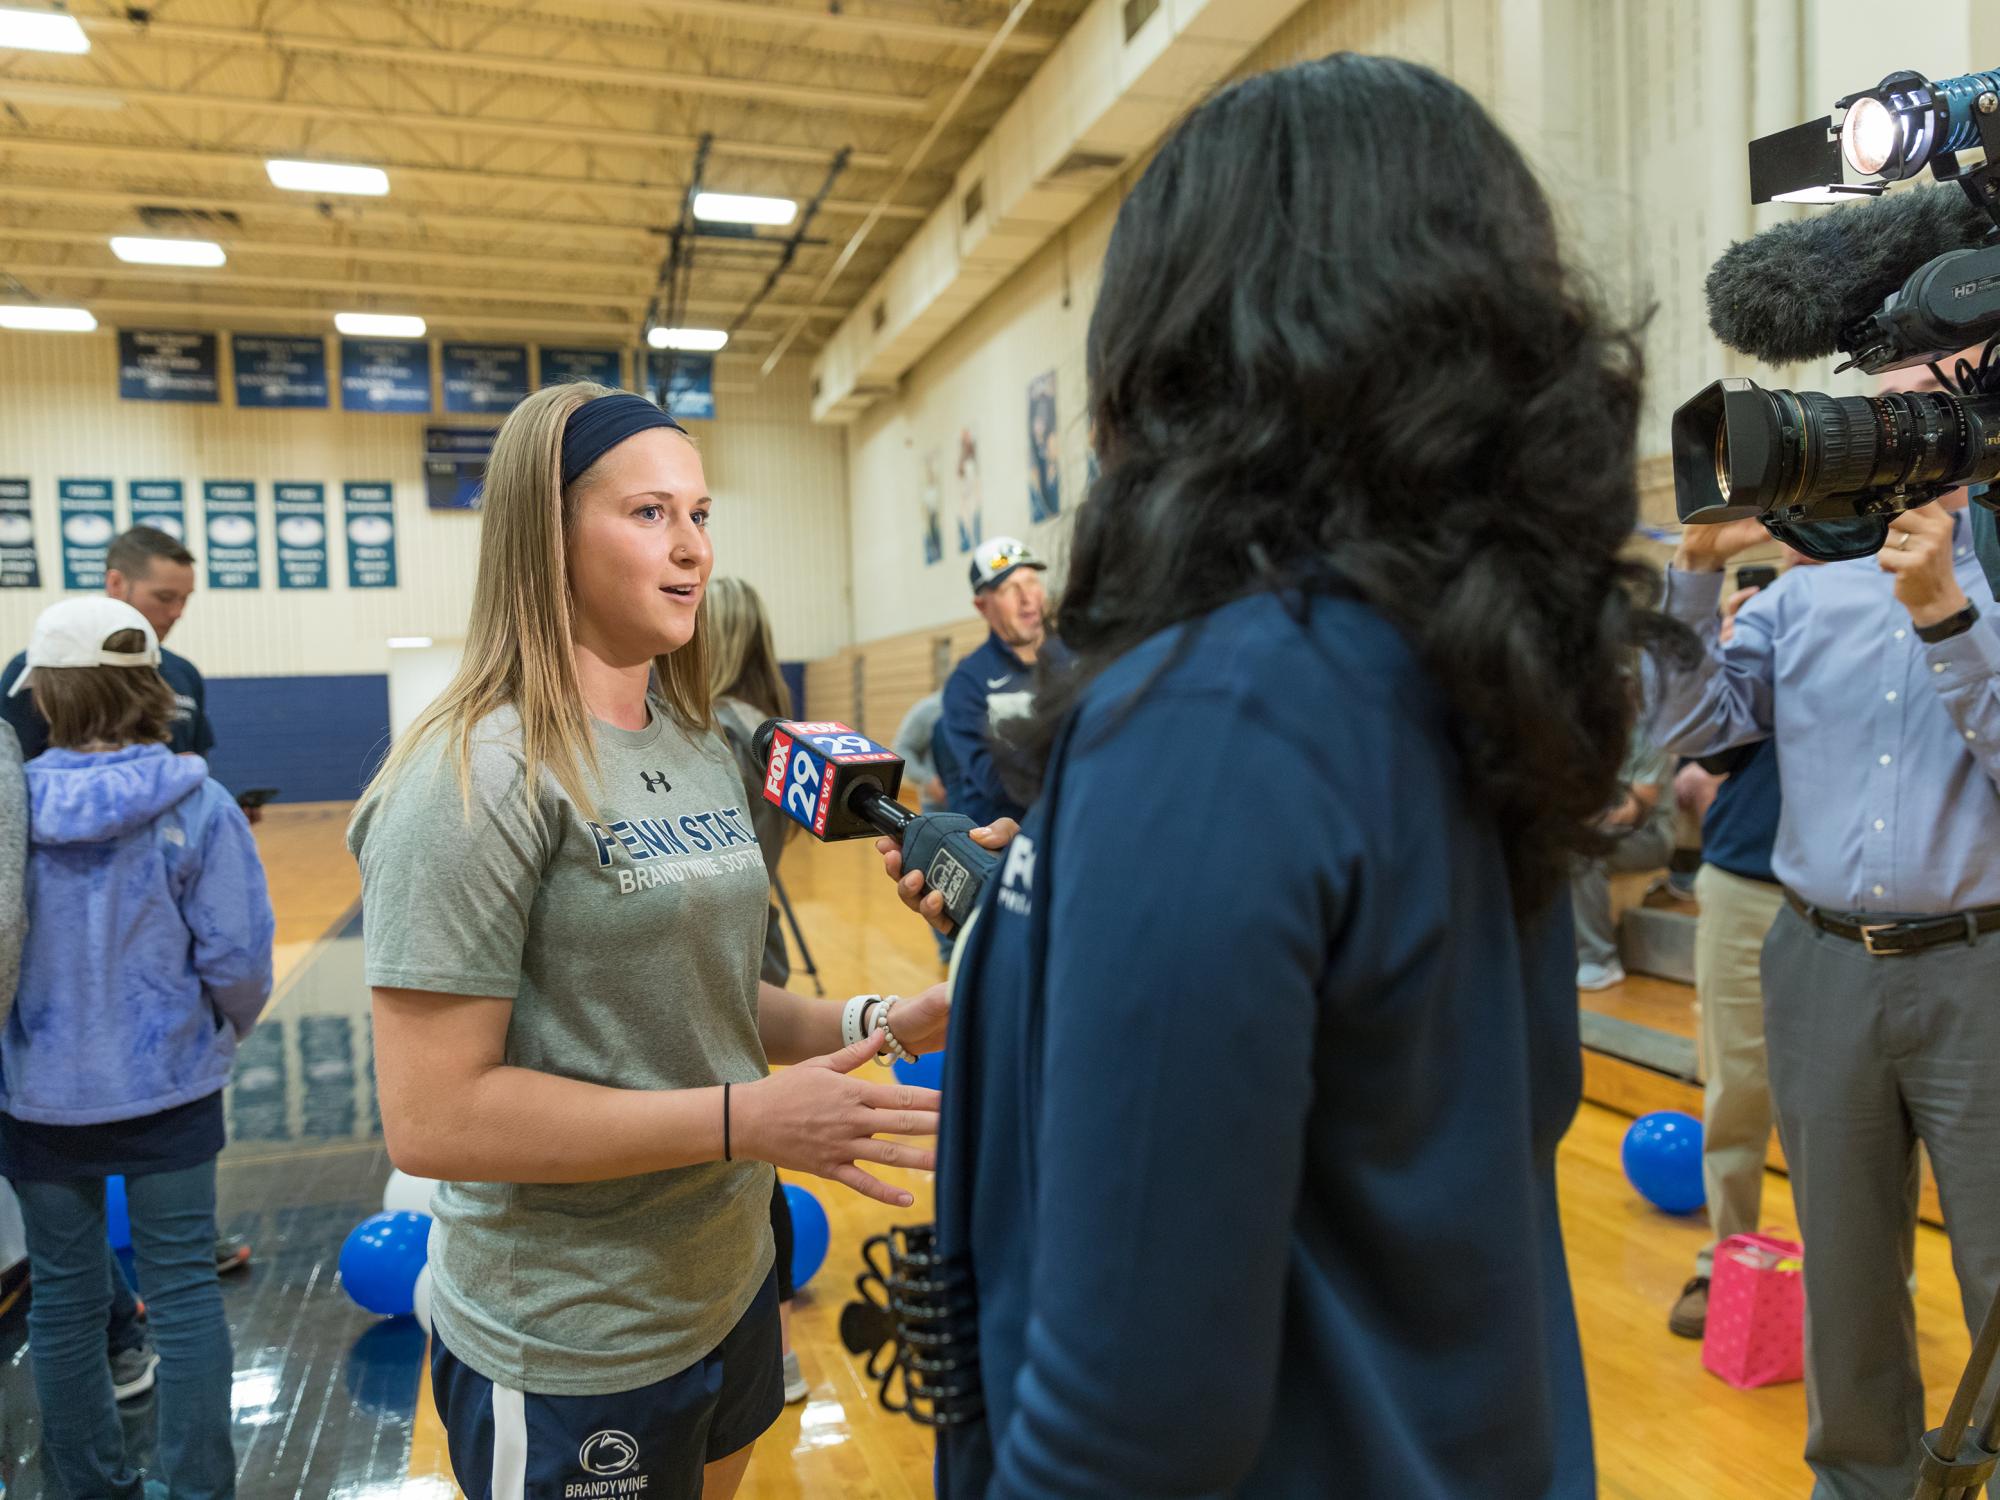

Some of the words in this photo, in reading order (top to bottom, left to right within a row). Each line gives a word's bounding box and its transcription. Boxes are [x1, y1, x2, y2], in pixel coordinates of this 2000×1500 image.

[1954, 283, 1977, 298] HD
[792, 723, 847, 733] FOX
[813, 735, 872, 755] 29
[840, 753, 893, 762] NEWS
[767, 738, 789, 798] FOX
[788, 751, 819, 824] 29
[816, 768, 833, 831] NEWS
[584, 818, 692, 868] PENN
[618, 857, 724, 895] BRANDYWINE
[565, 1475, 648, 1499] BRANDYWINE
